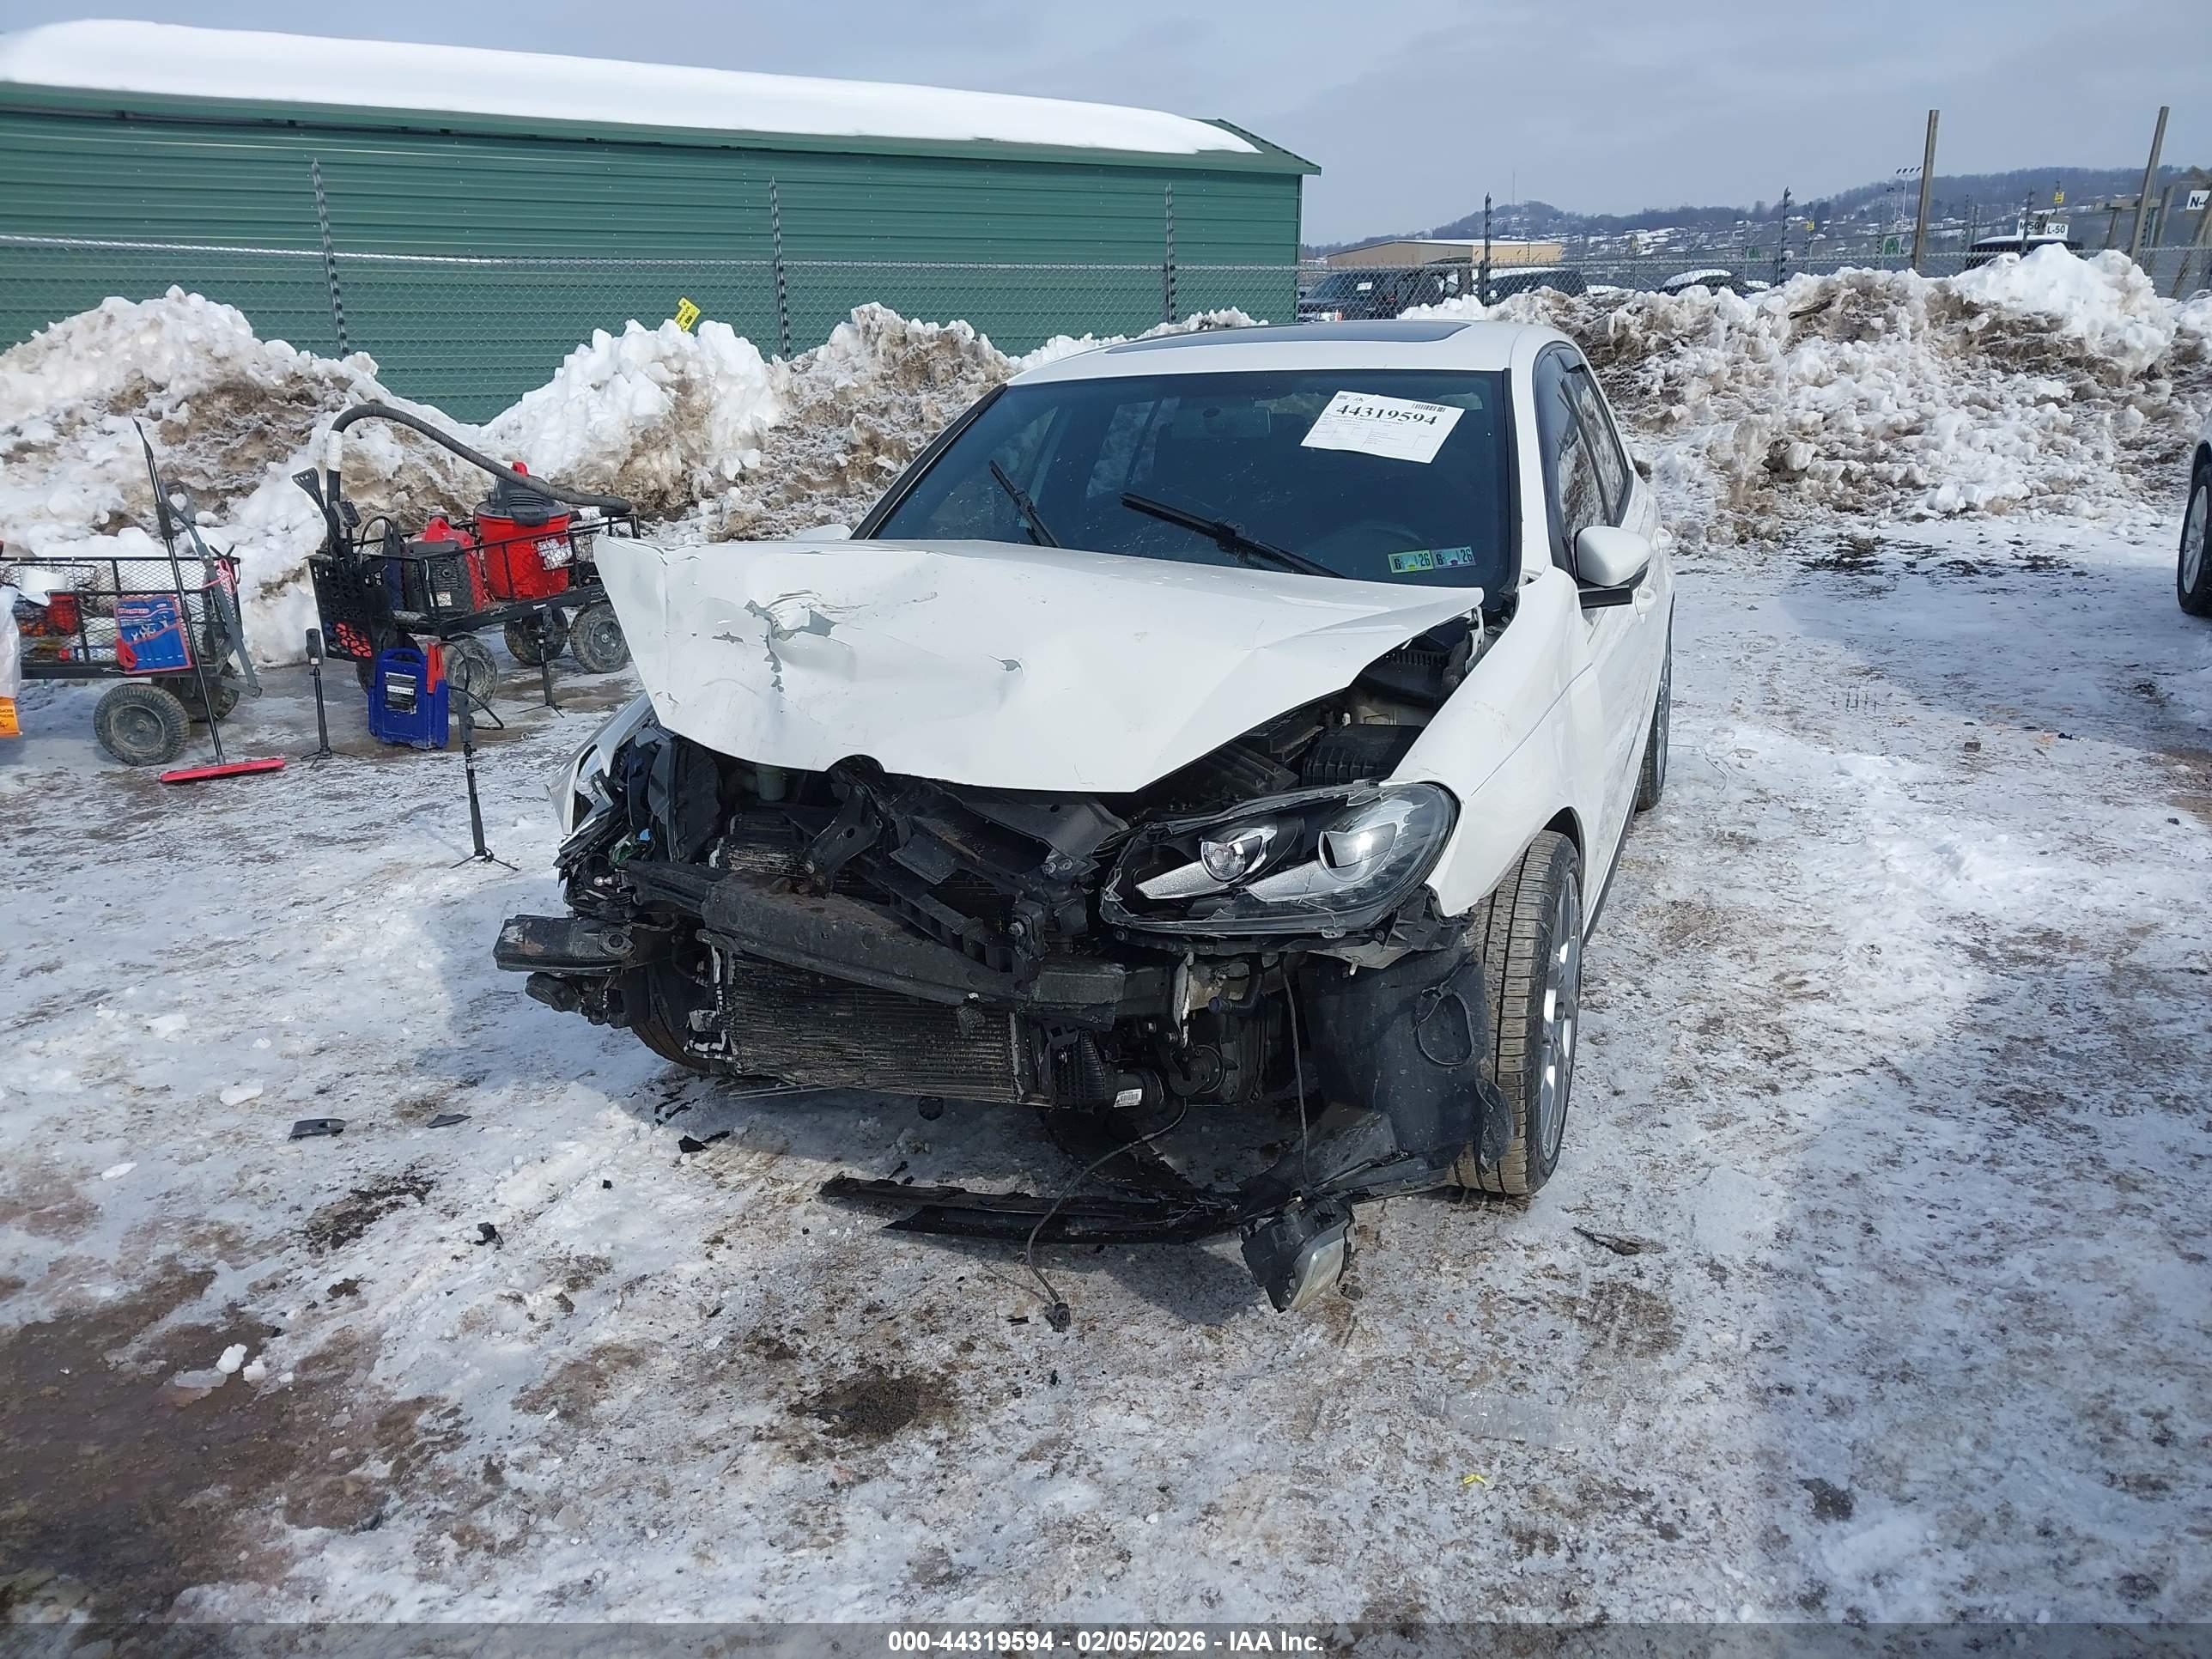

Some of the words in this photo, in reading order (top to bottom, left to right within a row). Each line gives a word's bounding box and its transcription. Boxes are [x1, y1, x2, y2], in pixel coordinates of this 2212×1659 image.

[2047, 225, 2066, 234] L-50
[1336, 404, 1438, 426] 44319594
[1419, 552, 1431, 567] 26
[1461, 548, 1473, 562] 26
